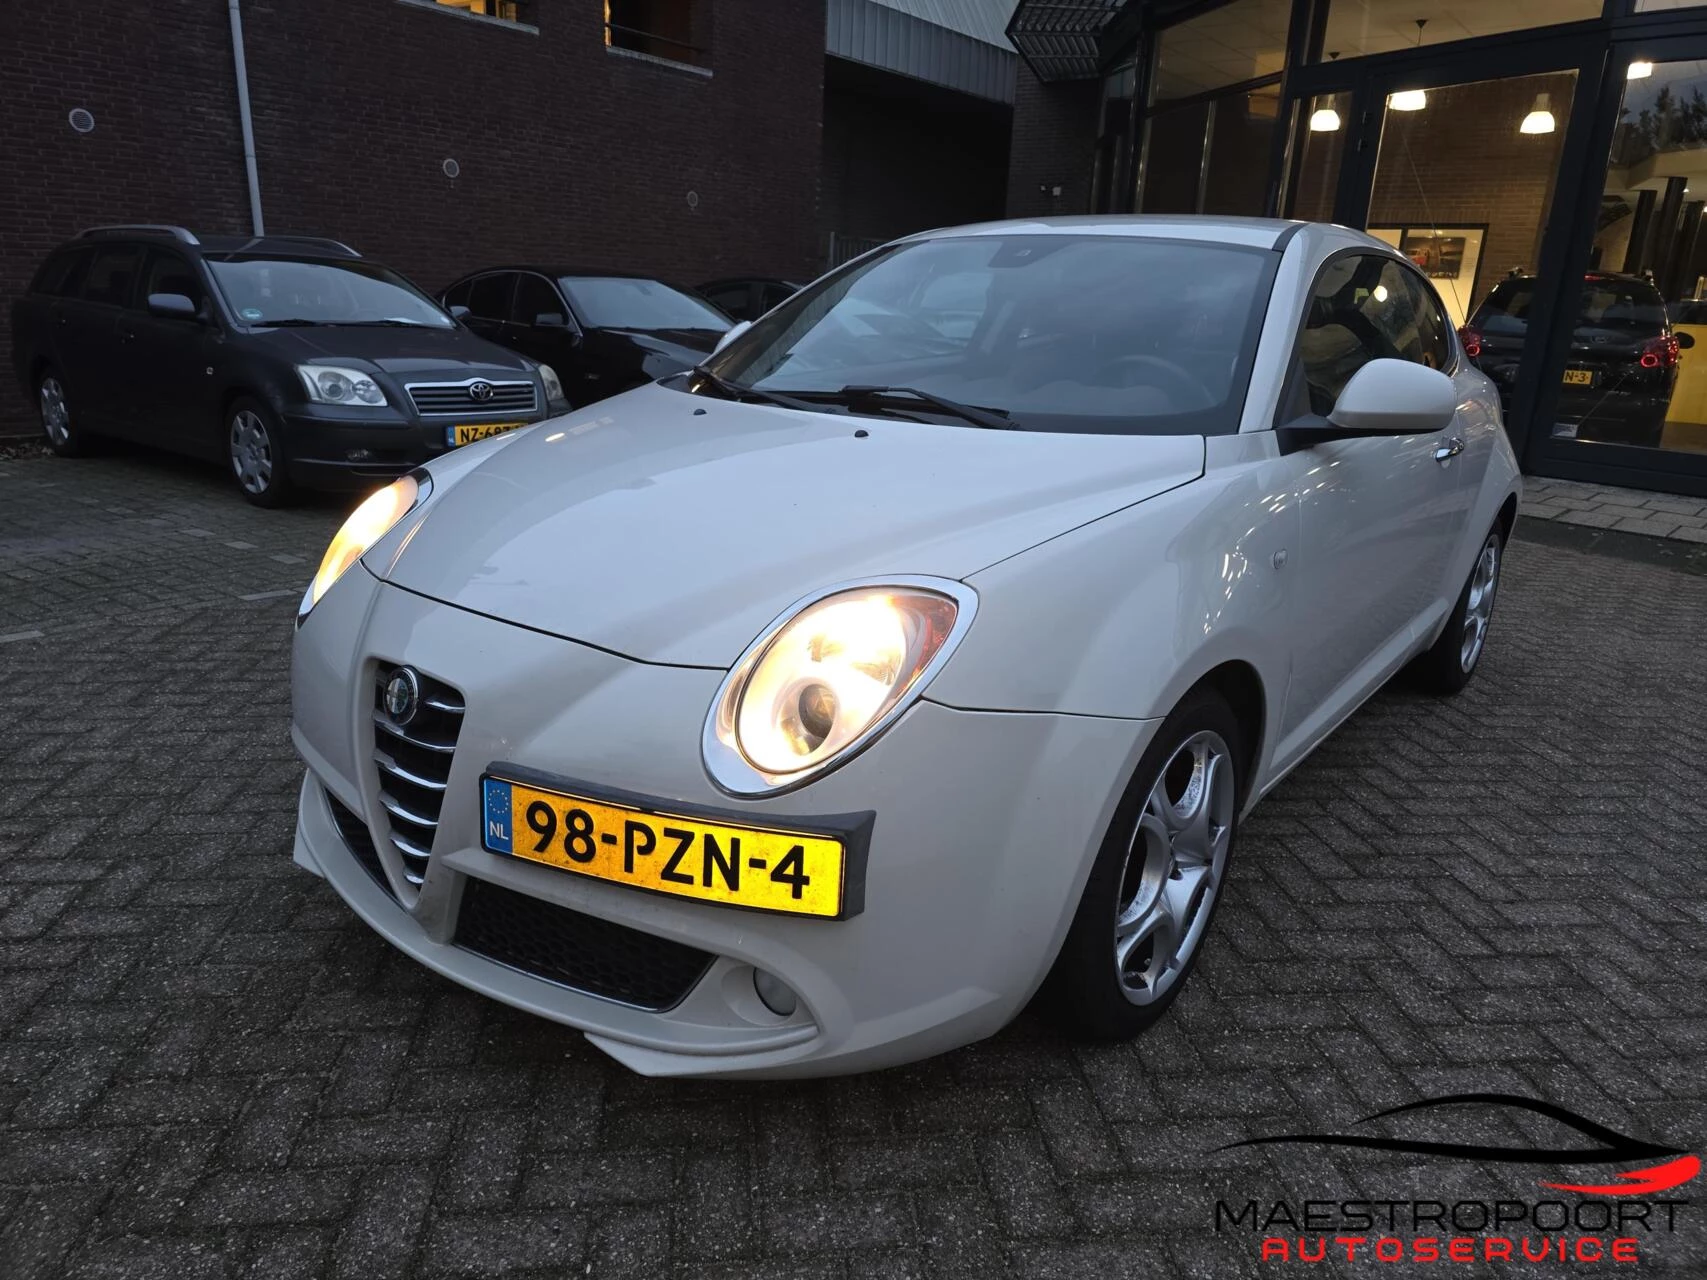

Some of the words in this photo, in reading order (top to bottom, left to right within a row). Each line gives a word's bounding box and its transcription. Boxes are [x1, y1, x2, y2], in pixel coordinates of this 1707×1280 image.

[1565, 372, 1587, 382] N-3
[489, 820, 508, 841] NL
[526, 800, 810, 899] 98-PZN-4
